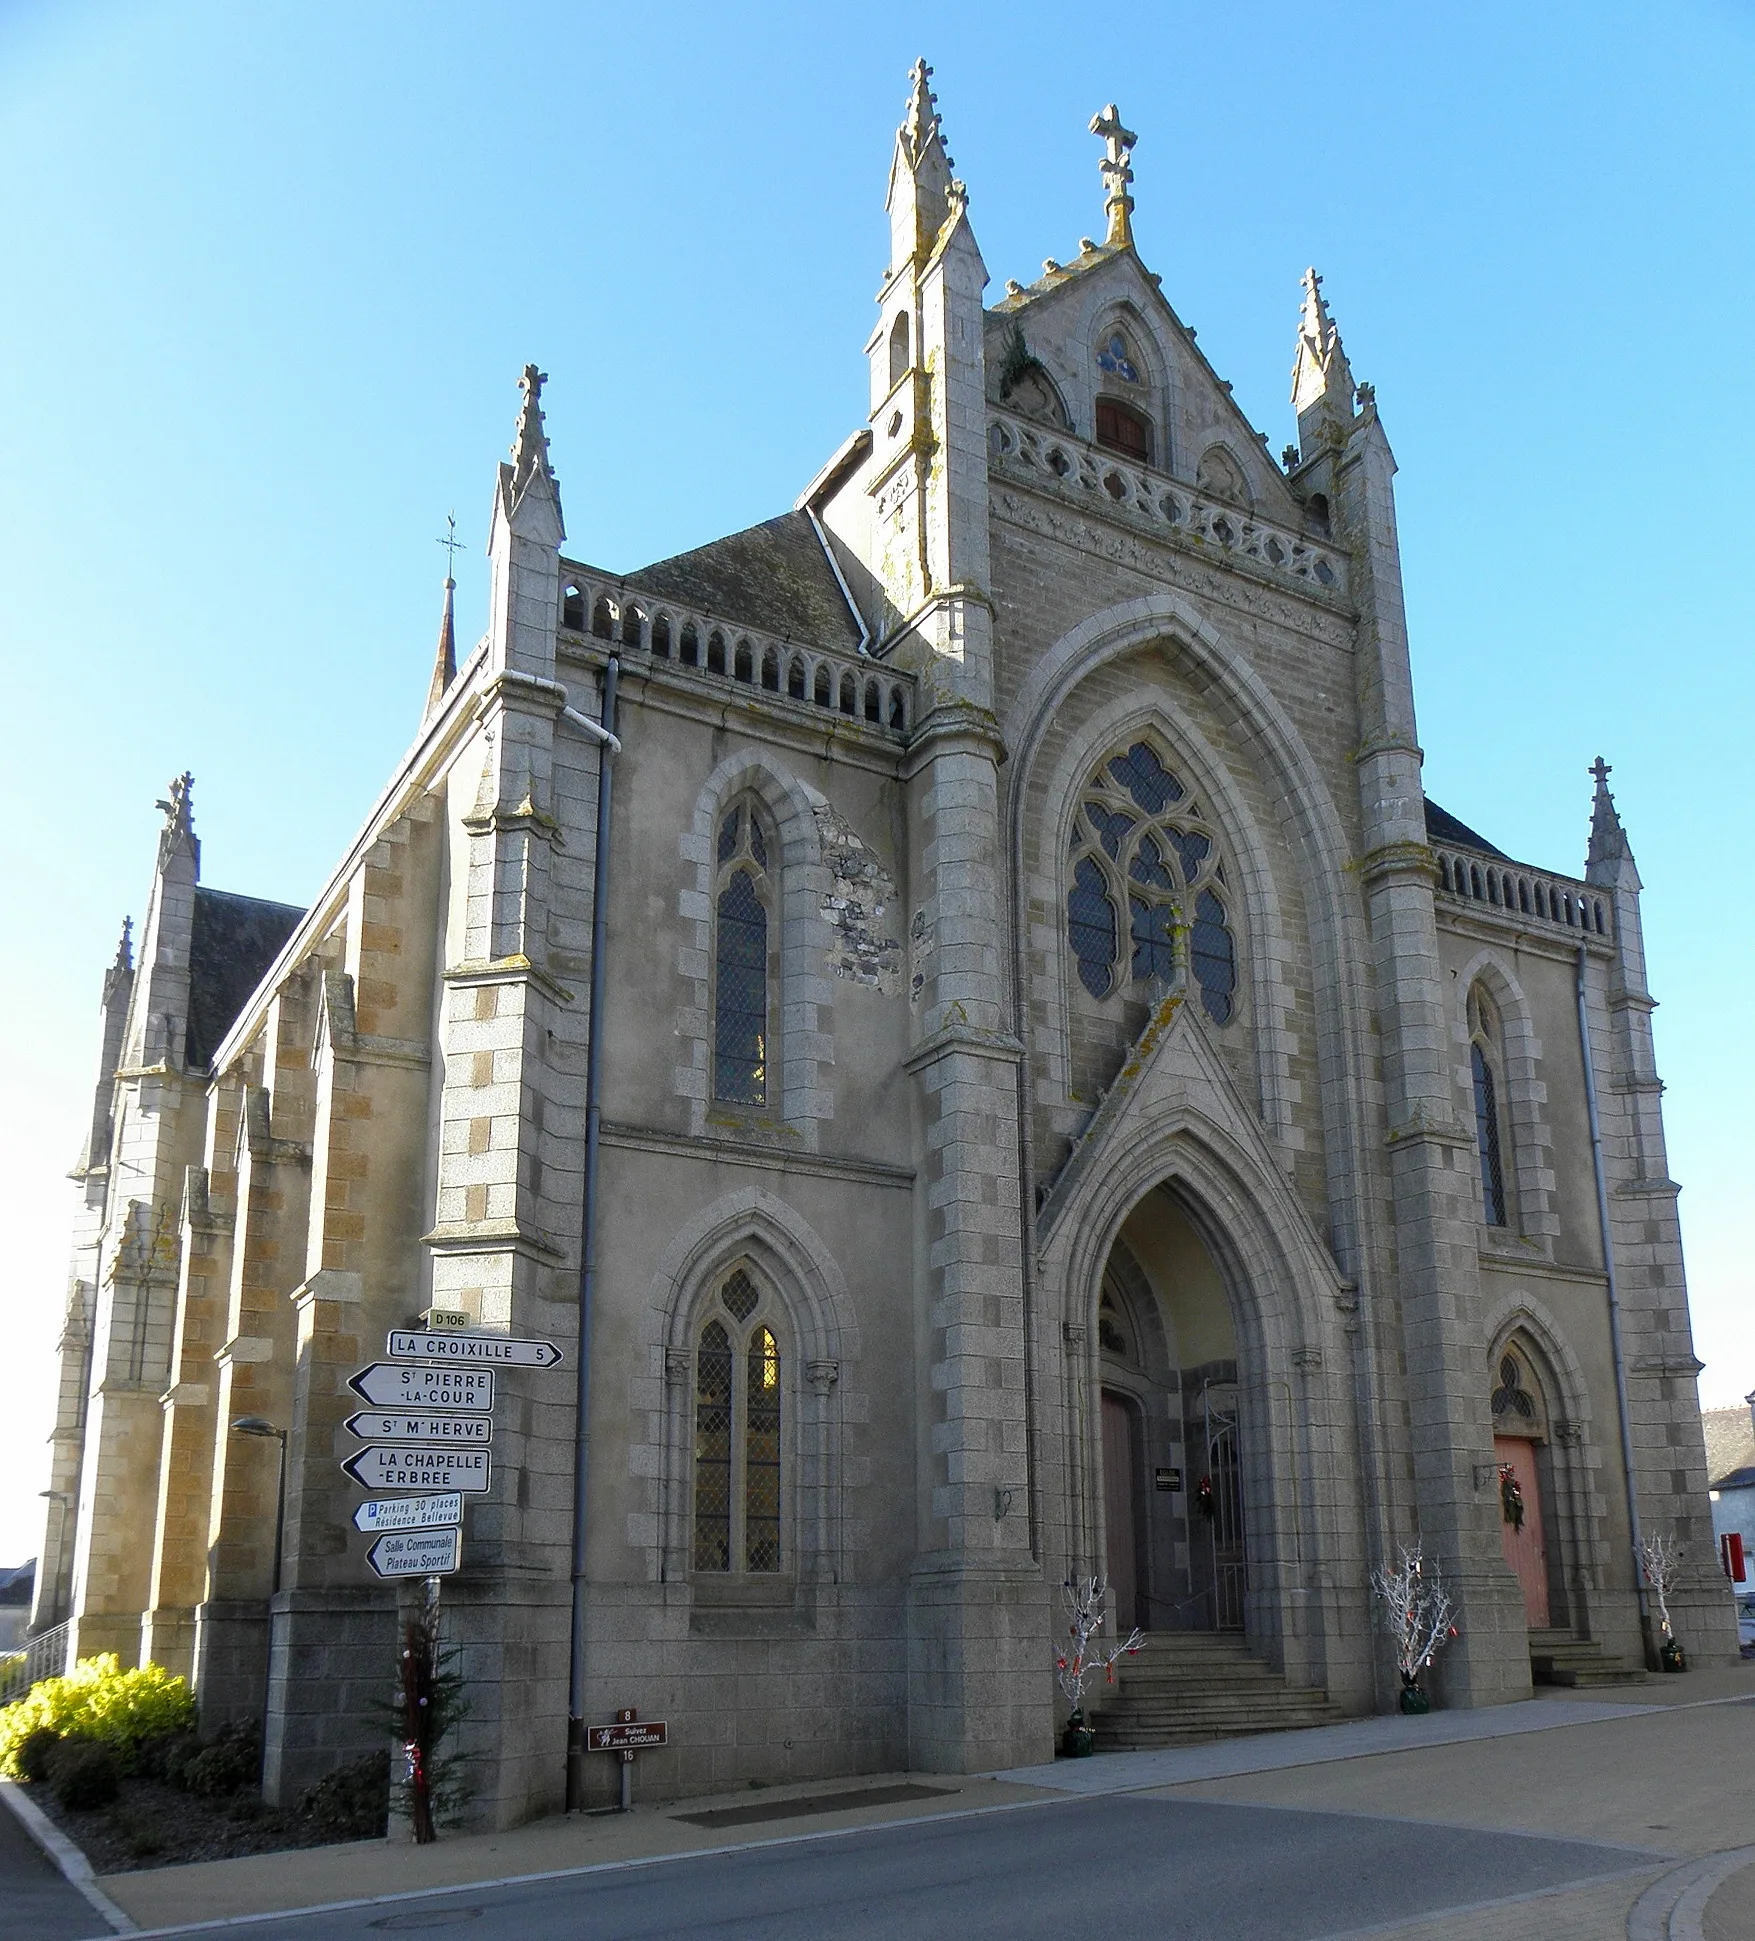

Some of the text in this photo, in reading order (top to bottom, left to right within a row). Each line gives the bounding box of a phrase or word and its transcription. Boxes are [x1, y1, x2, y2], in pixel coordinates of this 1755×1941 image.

[436, 1314, 465, 1326] D 106
[398, 1338, 544, 1360] LA CROIXILLE 5
[425, 1373, 486, 1388] PIERRE
[379, 1453, 483, 1469] LA CHAPELLE
[369, 1498, 459, 1516] P Parking 30 places
[375, 1511, 458, 1527] Résidence Bellevue
[384, 1535, 453, 1553] Salle Communale
[386, 1553, 451, 1570] Plateau Sportif
[624, 1710, 631, 1721] 8
[625, 1727, 647, 1735] Suivez
[612, 1734, 660, 1745] Jean CHOUAN
[623, 1750, 634, 1761] 16
